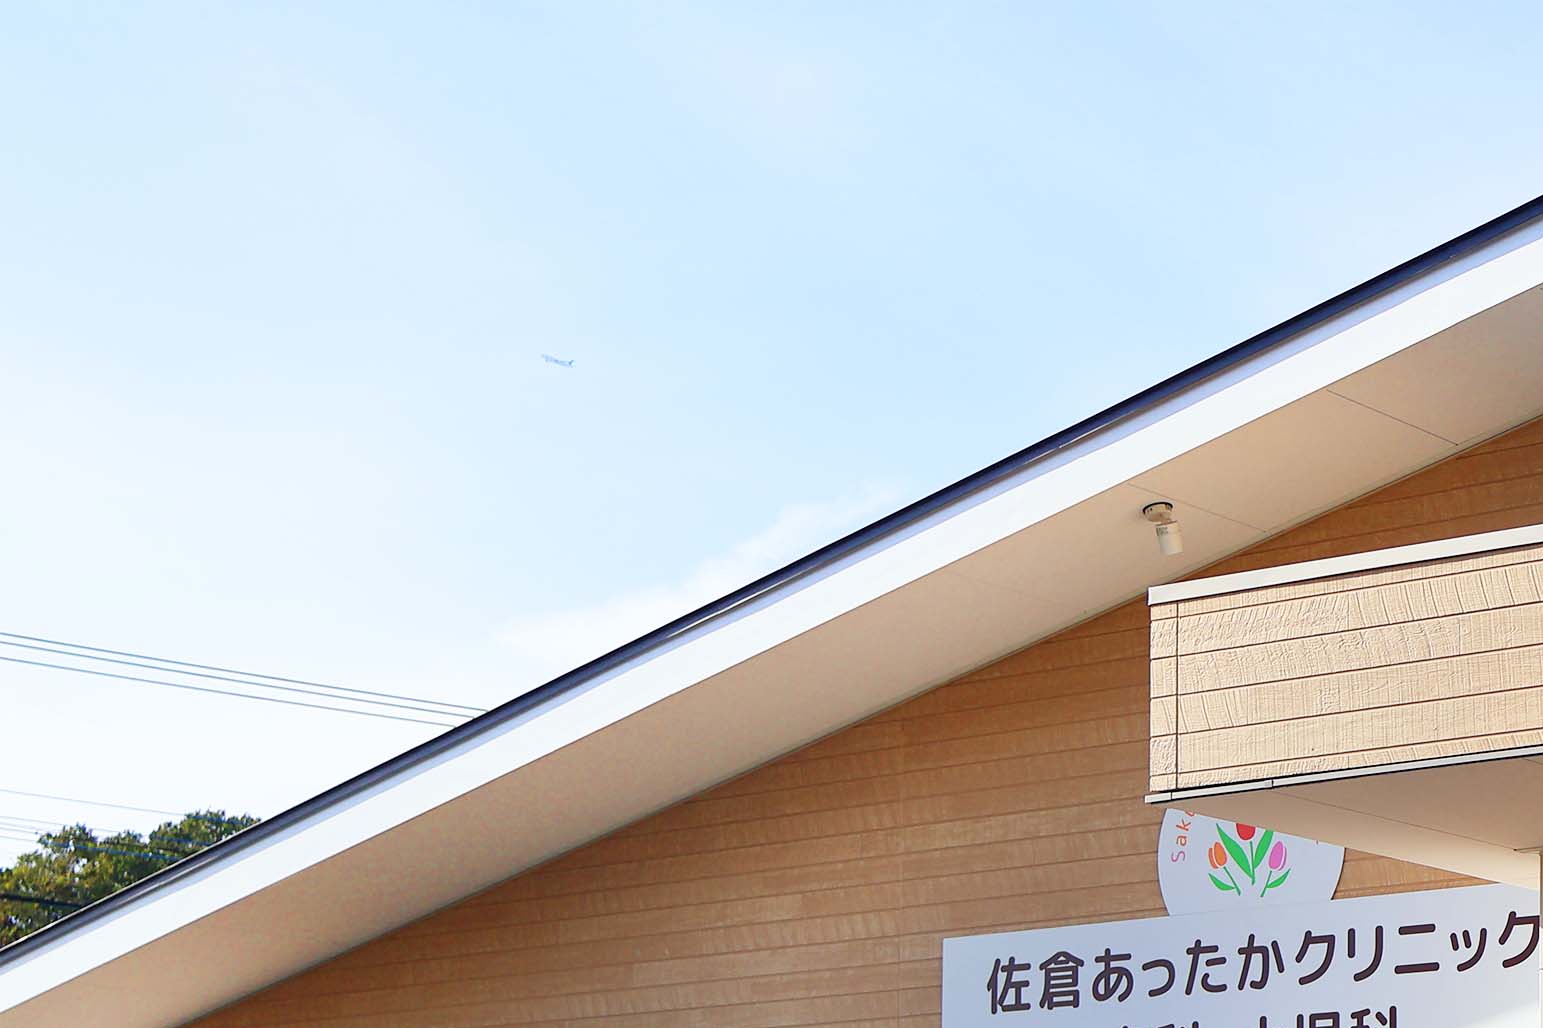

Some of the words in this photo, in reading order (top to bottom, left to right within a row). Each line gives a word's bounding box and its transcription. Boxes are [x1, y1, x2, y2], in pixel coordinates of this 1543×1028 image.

[986, 911, 1540, 1014] 佐倉あったかクリニック
